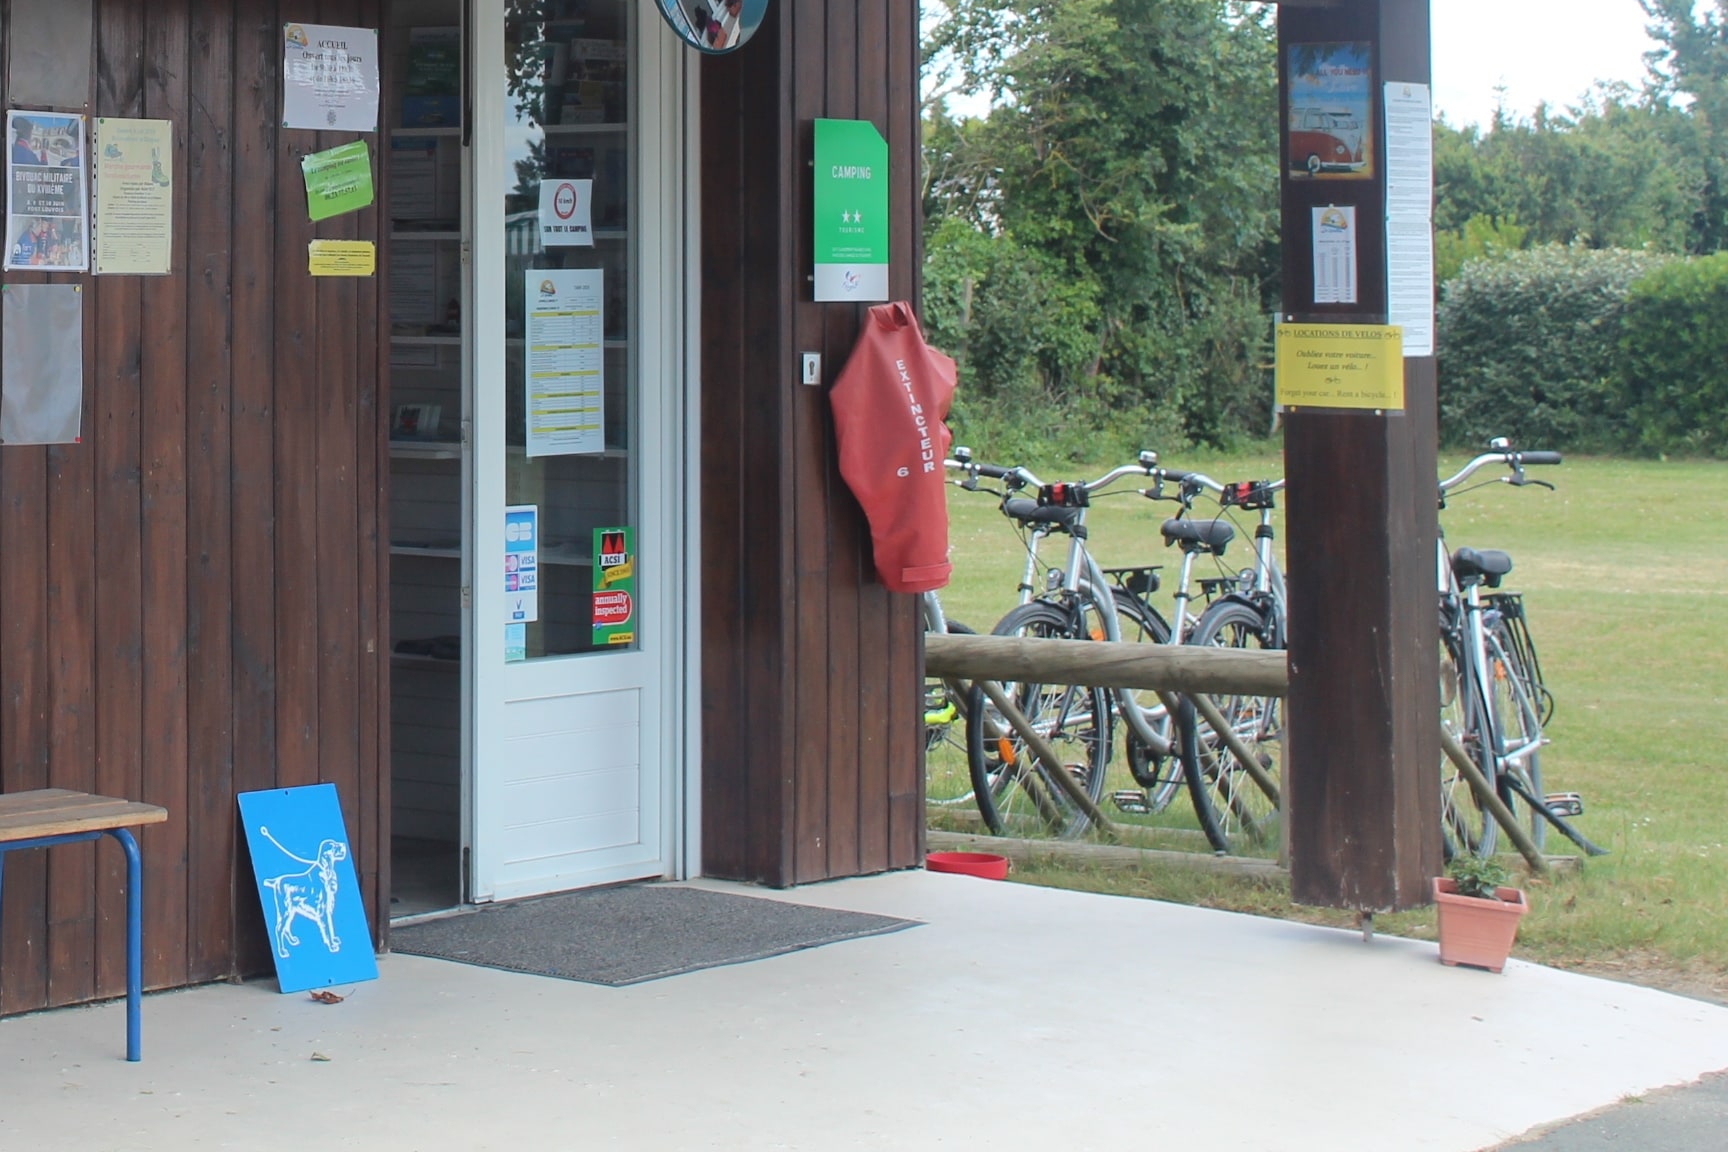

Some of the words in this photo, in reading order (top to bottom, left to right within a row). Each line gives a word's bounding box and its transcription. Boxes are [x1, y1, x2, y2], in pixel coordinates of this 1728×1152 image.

[317, 39, 348, 50] ACCUEIL
[302, 50, 323, 61] Ouvert
[347, 54, 363, 64] jours
[15, 170, 42, 182] BIVOUAC
[43, 171, 73, 184] MILITAIRE
[831, 165, 872, 180] CAMPING
[27, 183, 35, 193] DU
[553, 225, 563, 233] TOUT
[564, 225, 569, 233] LE
[569, 225, 587, 233] CAMPING
[838, 226, 865, 234] TOURISME
[1294, 330, 1340, 338] LOCATIONS
[1341, 330, 1353, 338] DE
[1307, 361, 1328, 370] Louez
[1280, 389, 1301, 399] Forget
[1302, 391, 1318, 399] your
[1336, 390, 1353, 398] Rent
[896, 359, 936, 473] EXTINCTEUR
[896, 466, 910, 477] 6
[506, 521, 532, 542] CB
[521, 555, 535, 566] VISA
[604, 554, 621, 564] ACSI
[521, 574, 535, 585] VISA
[595, 593, 628, 606] annually
[595, 605, 628, 617] inspected
